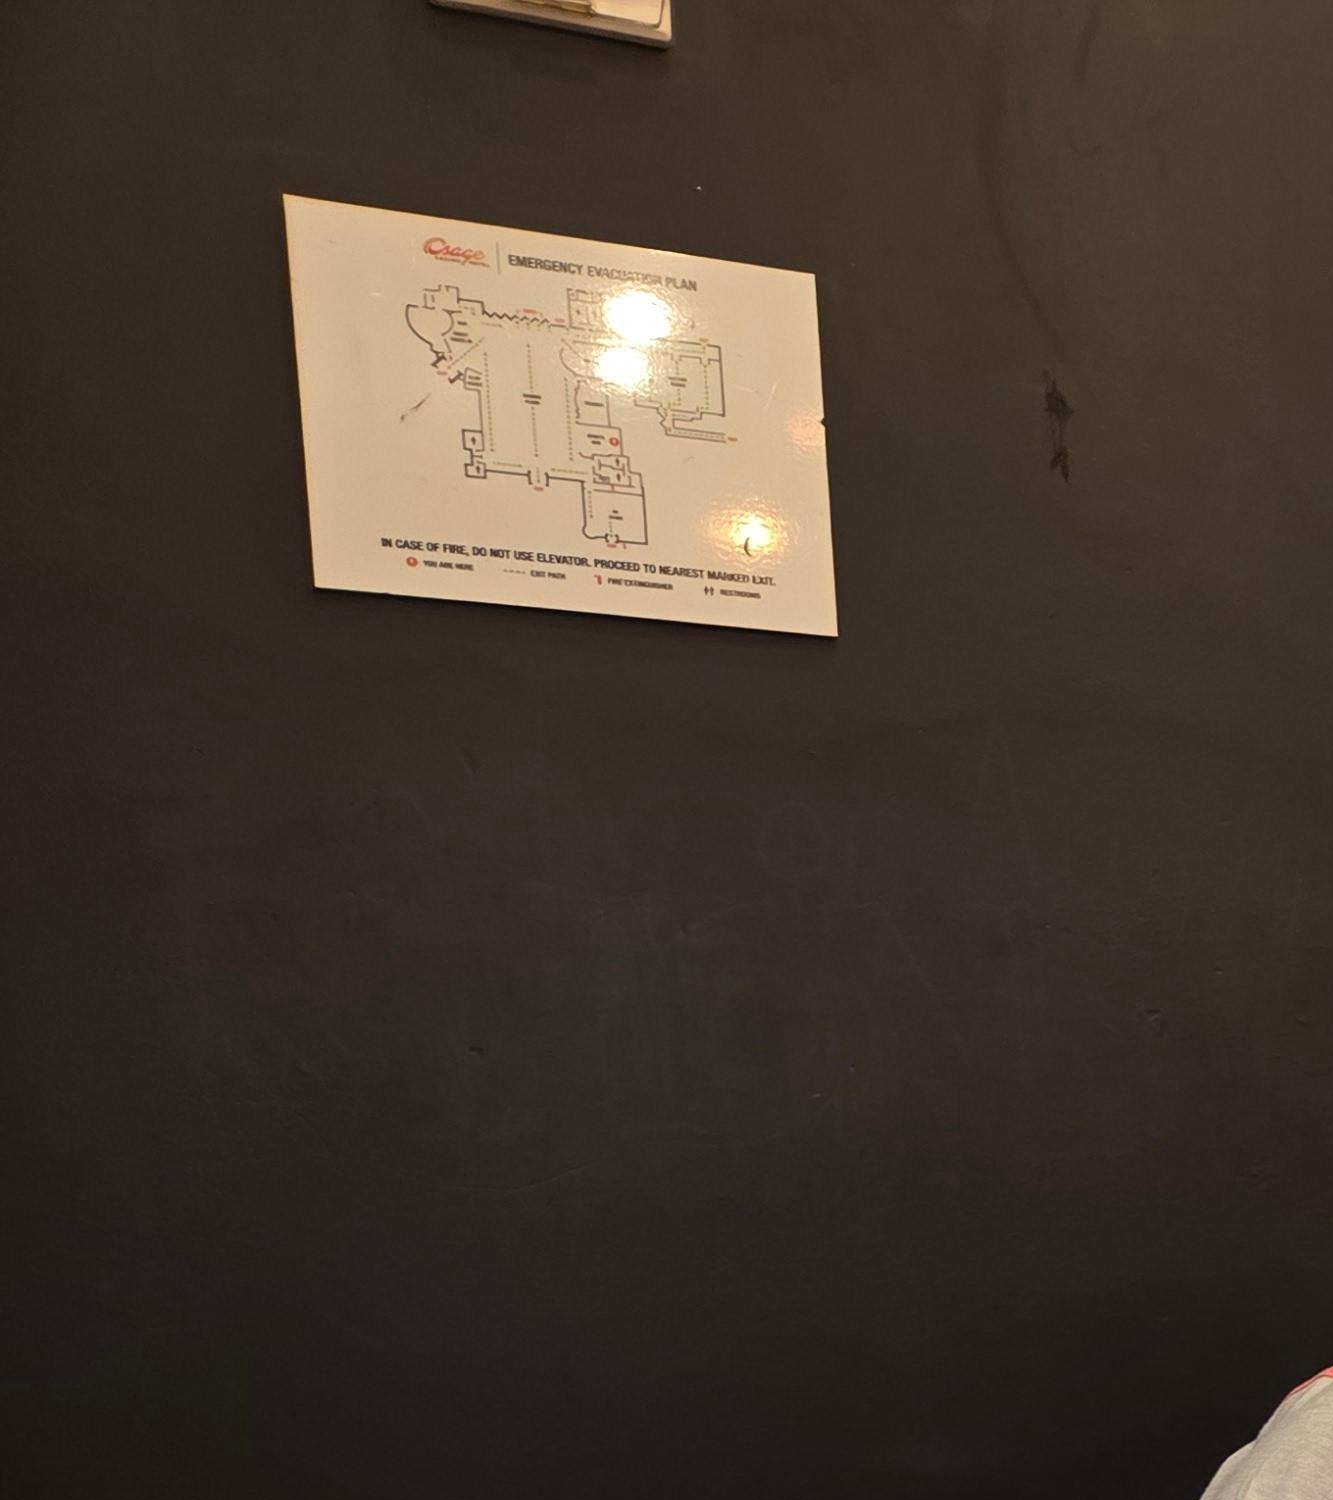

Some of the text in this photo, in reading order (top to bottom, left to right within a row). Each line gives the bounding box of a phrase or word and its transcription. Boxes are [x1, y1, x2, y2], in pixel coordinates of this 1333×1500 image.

[423, 237, 485, 265] Osage
[508, 254, 583, 275] EMERGENCY
[587, 265, 663, 286] EVACUATION
[665, 276, 697, 292] PLAN
[381, 537, 393, 548] IN
[395, 539, 423, 551] CASE
[426, 542, 440, 552] OF
[472, 546, 487, 557] DO
[490, 548, 511, 559] NOT
[514, 550, 533, 562] USE
[594, 558, 640, 572] PROCEED
[644, 563, 656, 574] TO
[659, 565, 704, 579] NEAREST
[707, 570, 749, 583] MARKED
